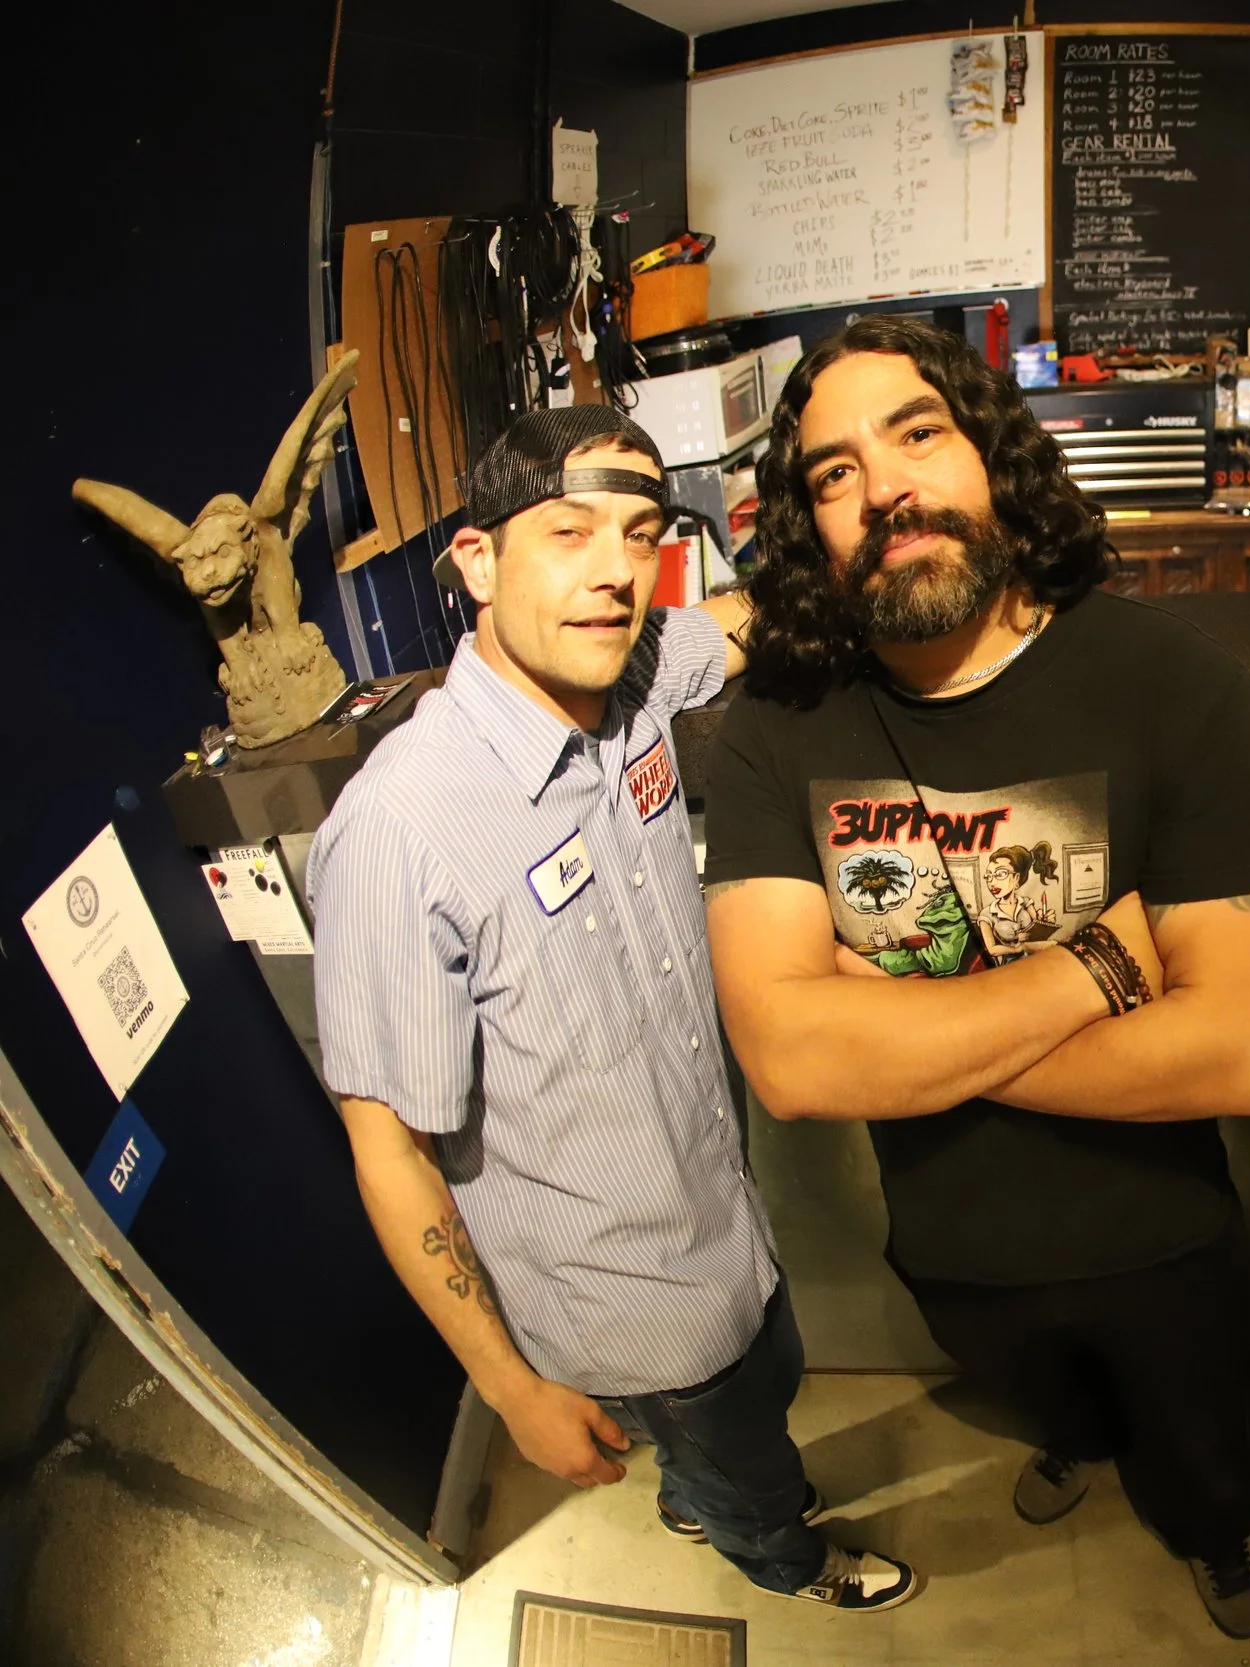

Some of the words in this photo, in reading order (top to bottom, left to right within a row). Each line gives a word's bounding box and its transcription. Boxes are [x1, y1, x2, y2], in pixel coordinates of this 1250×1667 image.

[1065, 44, 1110, 60] ROOM
[1117, 43, 1168, 60] RATES
[1064, 71, 1101, 84] Room
[1064, 88, 1099, 100] Room
[1128, 86, 1156, 100] $20
[1062, 102, 1100, 114] Room
[1128, 99, 1155, 113] $20
[1063, 121, 1099, 132] Room
[783, 130, 826, 149] FRUIT
[829, 123, 873, 144] SODA
[1062, 134, 1104, 150] GEAR
[1113, 132, 1175, 149] RENTAL
[764, 159, 800, 175] RED
[803, 151, 848, 169] BULL
[759, 172, 821, 196] SPARKLING
[793, 215, 836, 236] CHIPS
[755, 262, 807, 284] LIQUID
[815, 256, 853, 275] DEATH
[1157, 416, 1197, 427] HUSKY
[225, 848, 269, 861] FREEFALL
[559, 857, 584, 888] Adam
[1084, 953, 1099, 970] Do?
[126, 1000, 155, 1039] venmo
[109, 1136, 140, 1194] EXIT
